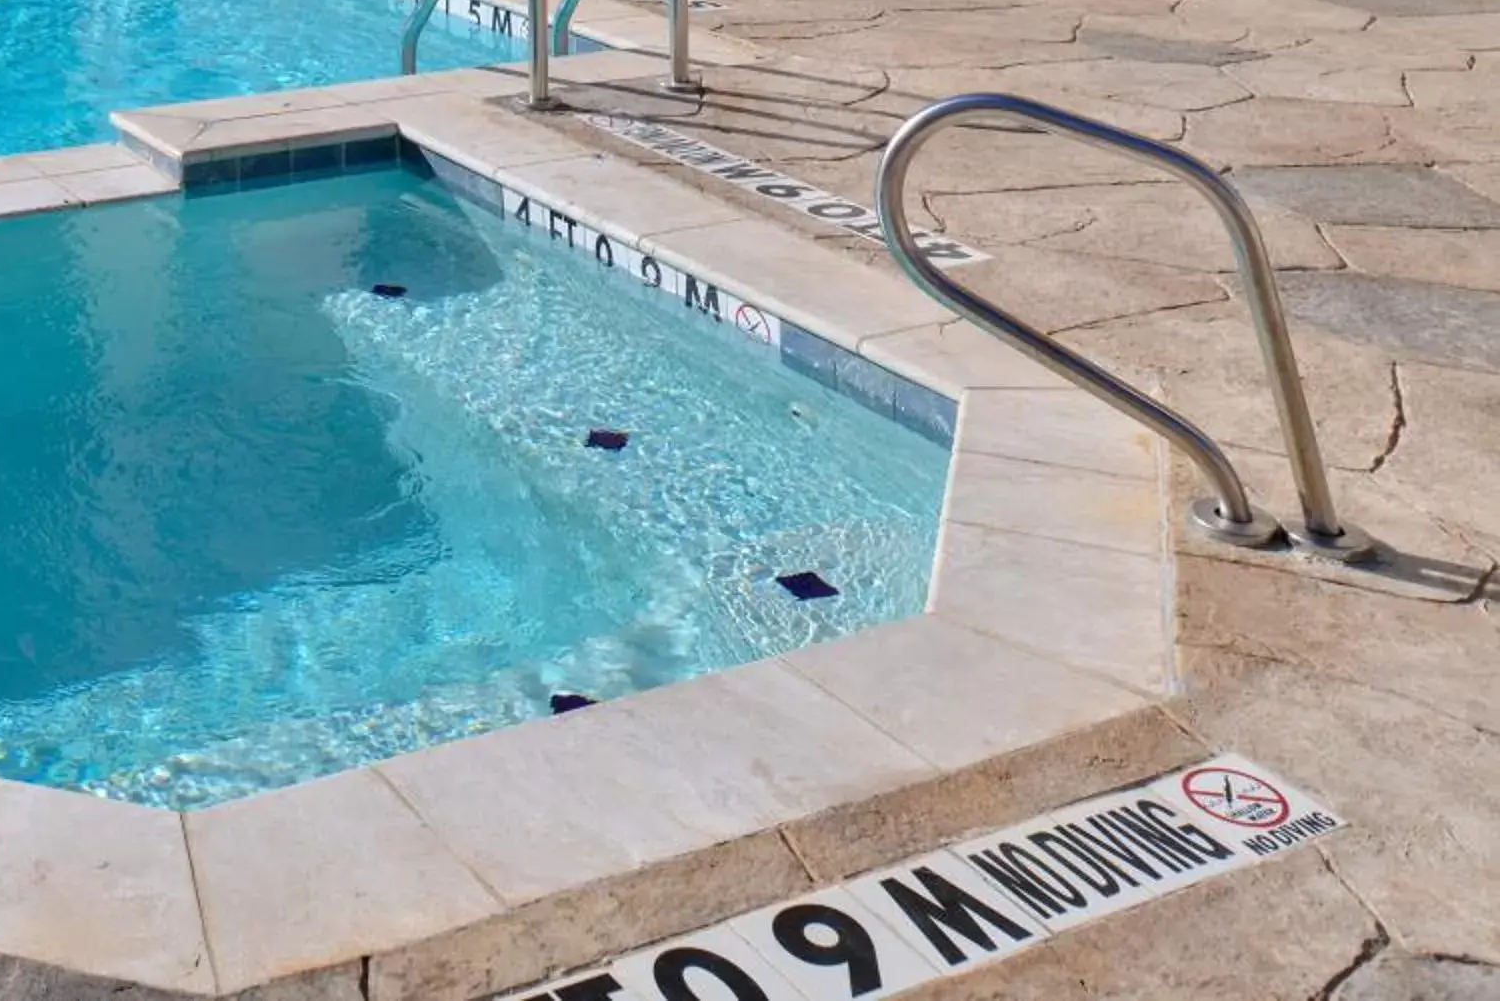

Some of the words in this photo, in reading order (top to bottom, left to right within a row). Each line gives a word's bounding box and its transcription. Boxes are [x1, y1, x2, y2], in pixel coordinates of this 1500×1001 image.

[469, 0, 481, 27] 5
[491, 6, 512, 37] M
[515, 196, 531, 226] 4
[549, 208, 577, 247] FT
[685, 273, 723, 323] M
[968, 842, 1088, 919] NO
[1026, 799, 1235, 898] DIVING
[1241, 834, 1279, 856] NO
[1267, 811, 1336, 845] DIVING
[772, 903, 882, 998] 9
[879, 866, 1034, 966] M
